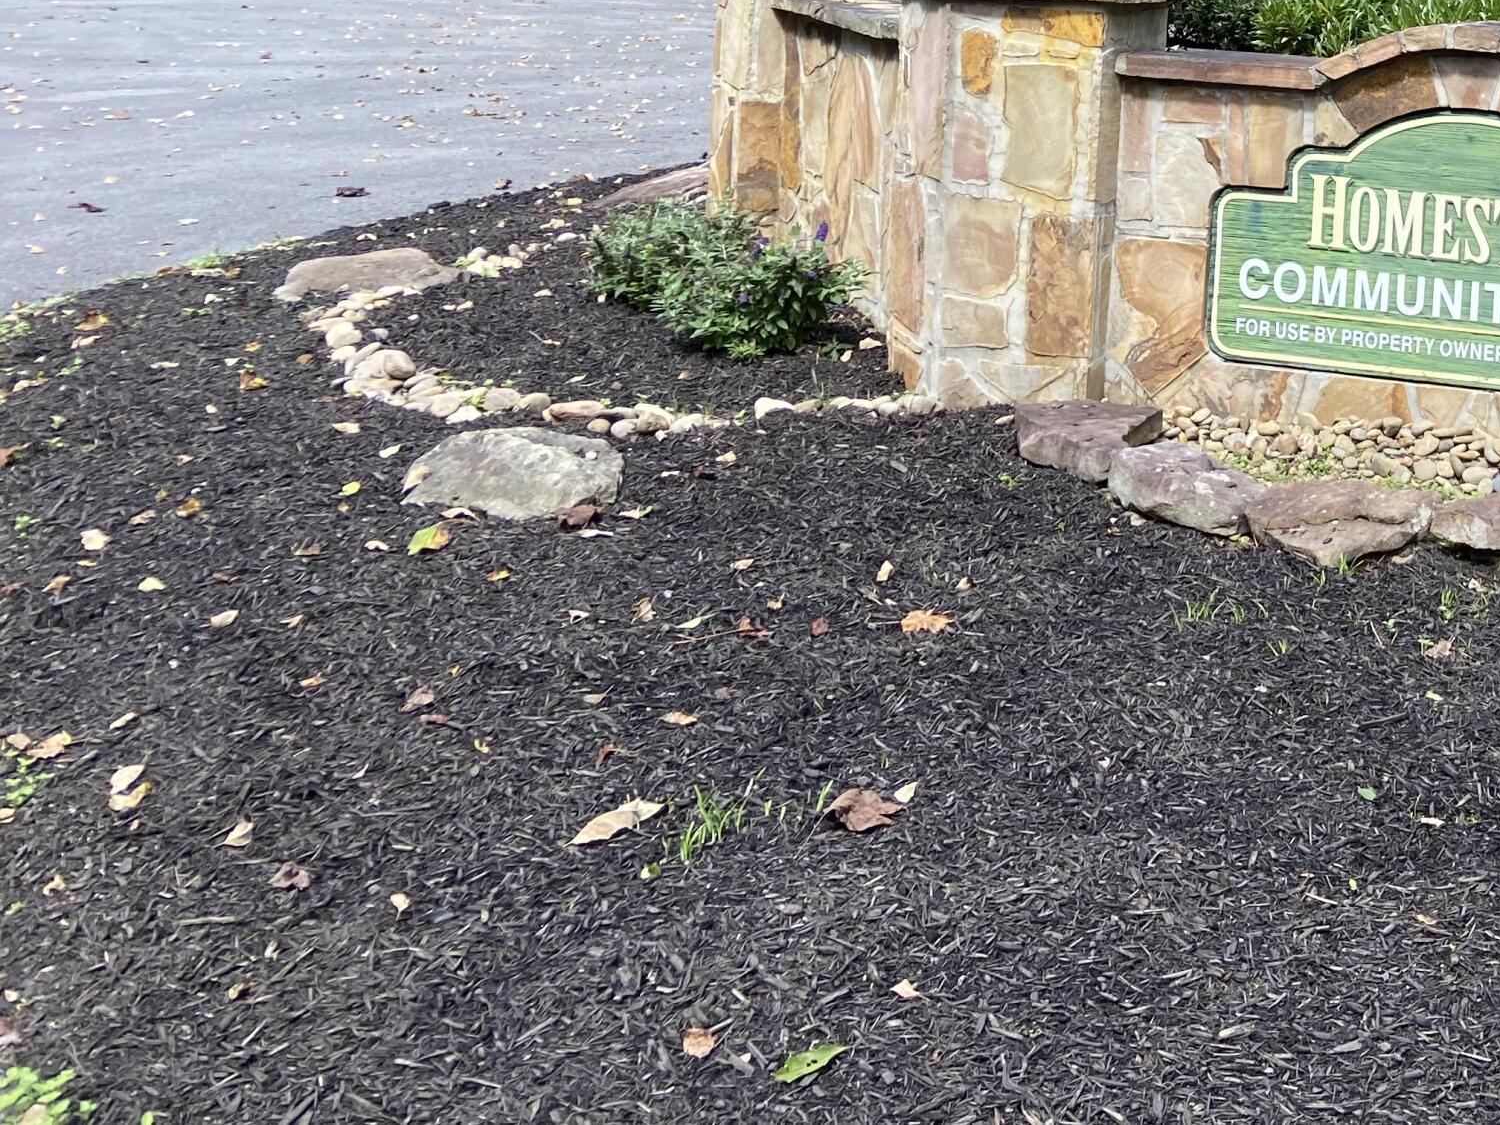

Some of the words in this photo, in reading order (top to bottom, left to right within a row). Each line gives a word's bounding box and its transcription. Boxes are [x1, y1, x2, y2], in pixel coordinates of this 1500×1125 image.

[1236, 318, 1270, 336] FOR
[1275, 321, 1310, 341] USE
[1314, 325, 1337, 343] BY
[1340, 328, 1436, 354] PROPERTY
